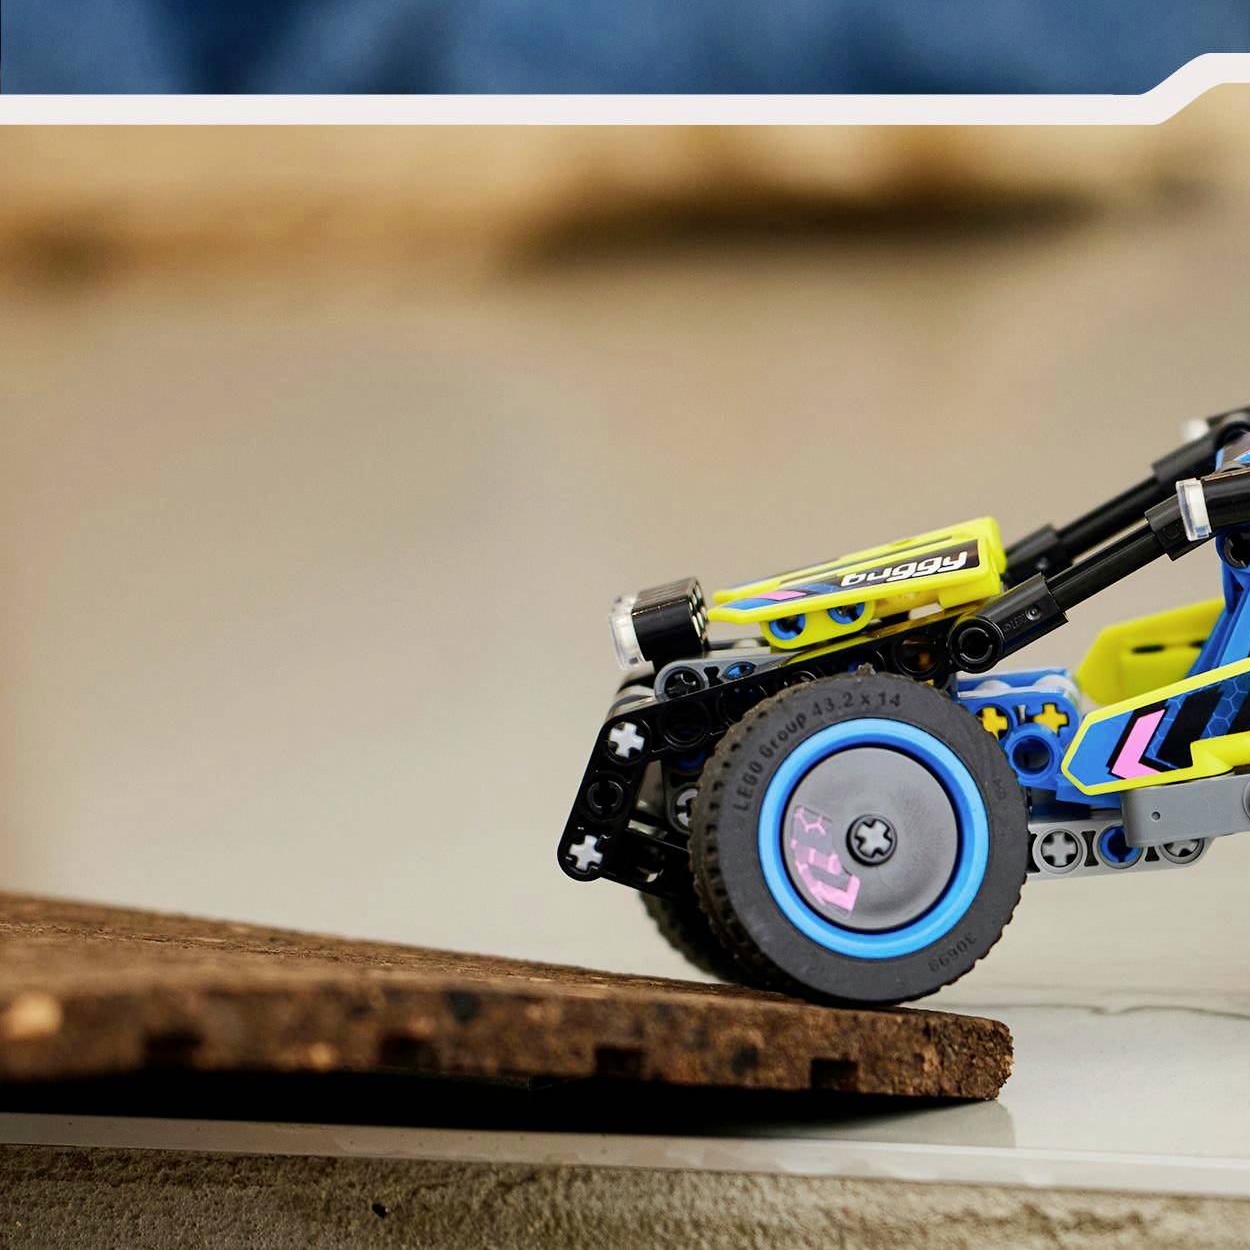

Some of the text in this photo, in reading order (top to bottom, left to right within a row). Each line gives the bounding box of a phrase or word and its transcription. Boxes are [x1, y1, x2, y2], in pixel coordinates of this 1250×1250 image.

[840, 551, 968, 587] buggy
[733, 760, 763, 812] LEGO
[760, 711, 807, 759] Group
[812, 692, 854, 717] 43.2
[877, 692, 901, 708] 14
